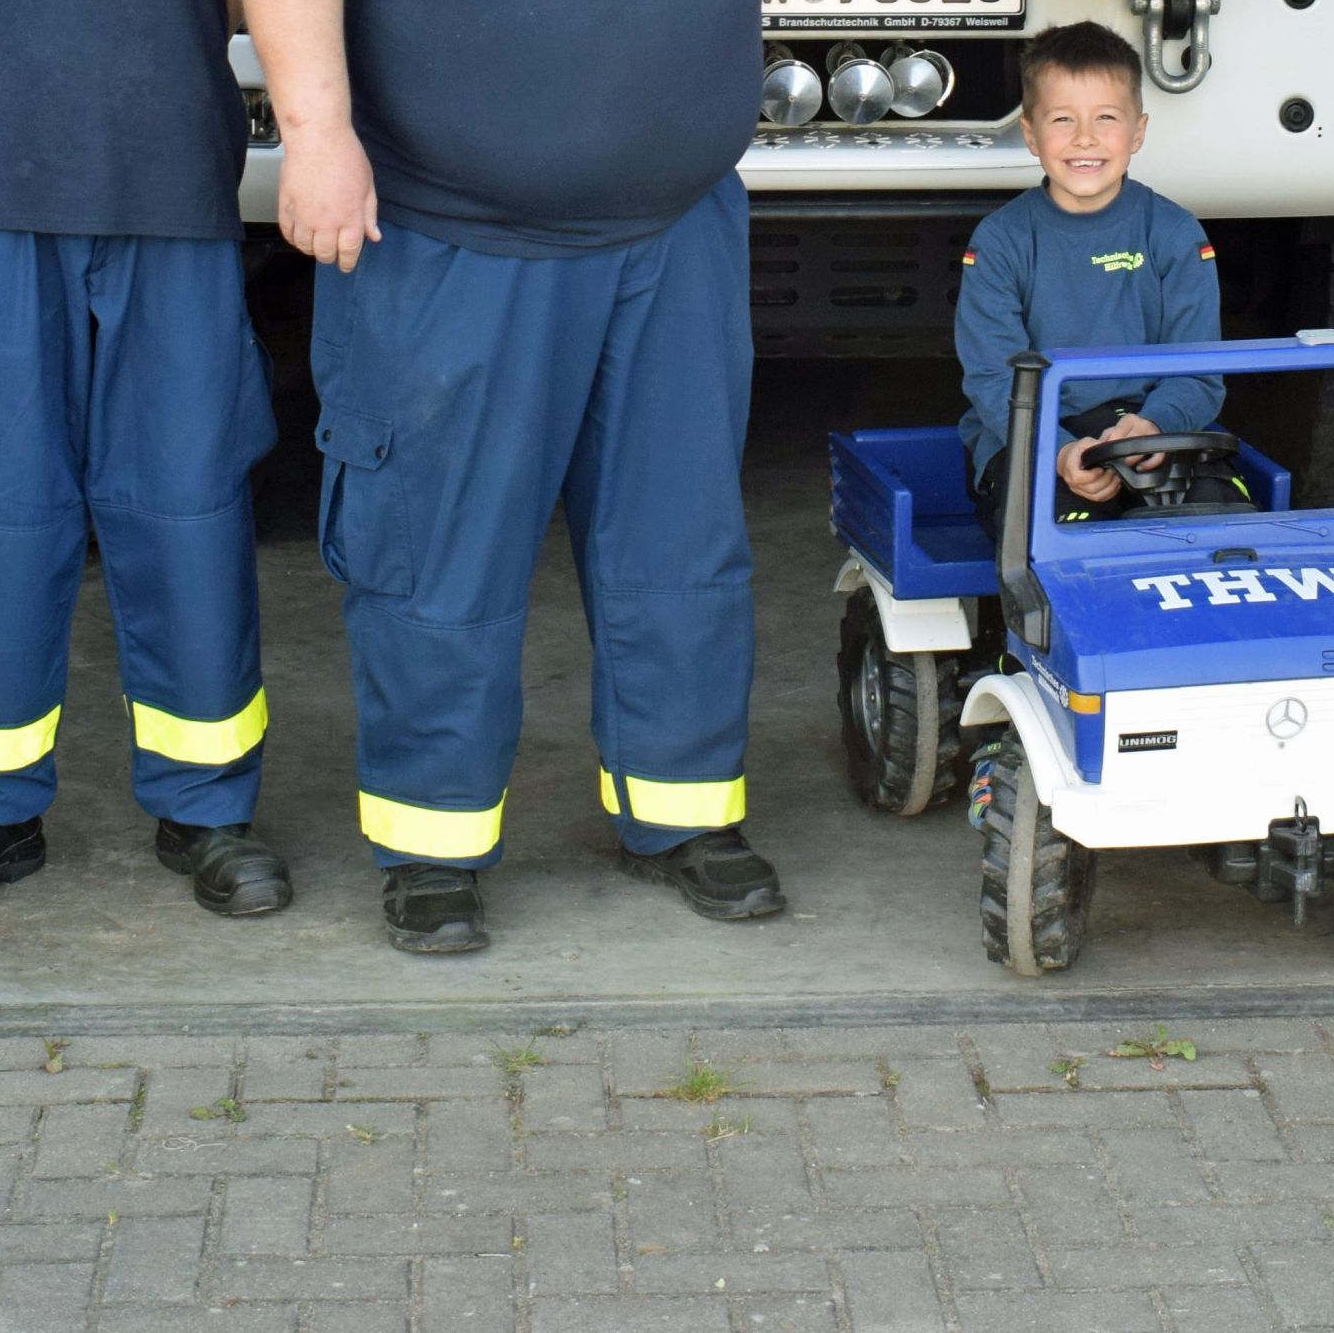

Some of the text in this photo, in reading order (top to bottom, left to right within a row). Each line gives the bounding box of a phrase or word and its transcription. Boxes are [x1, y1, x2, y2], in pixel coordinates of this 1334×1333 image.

[779, 17, 879, 27] Brandschutztechnik
[884, 17, 916, 27] GmbH
[921, 17, 961, 27] D-79367
[965, 17, 1009, 27] Weisweil
[1119, 734, 1178, 747] UNIMOG
